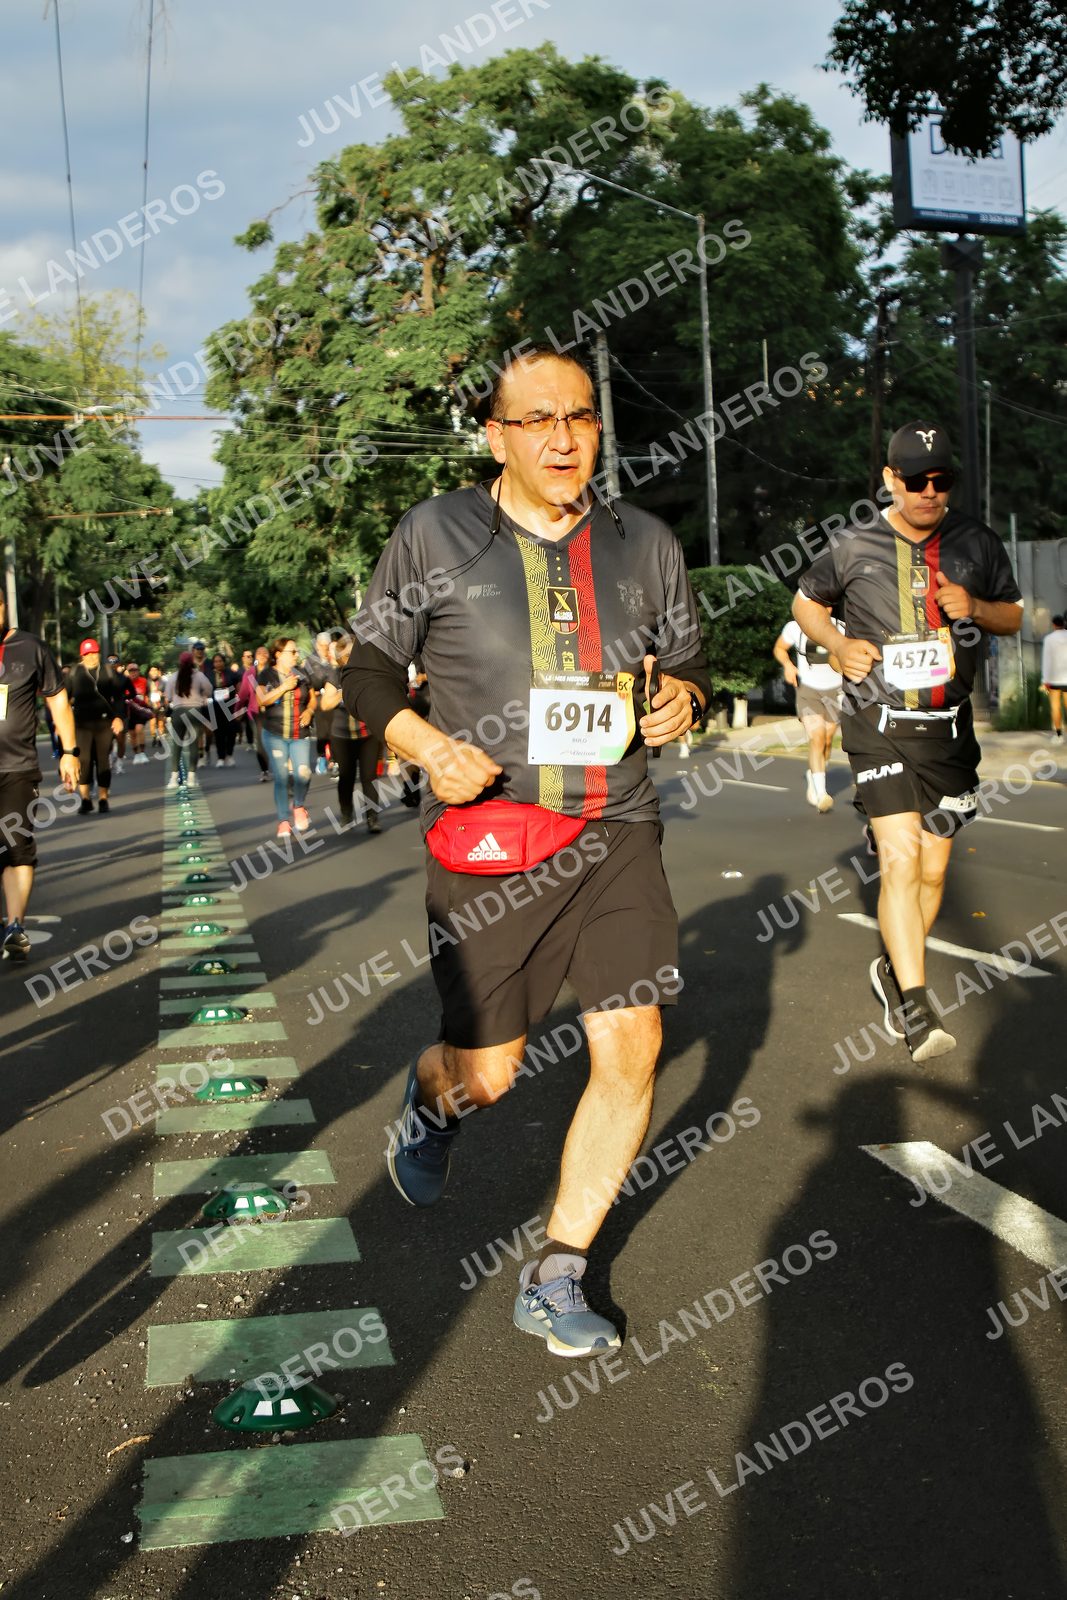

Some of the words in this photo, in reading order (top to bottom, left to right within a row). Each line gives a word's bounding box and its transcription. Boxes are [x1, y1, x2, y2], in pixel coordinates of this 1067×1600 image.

[893, 648, 940, 670] 4572
[545, 702, 612, 733] 6914
[467, 849, 508, 861] adidas
